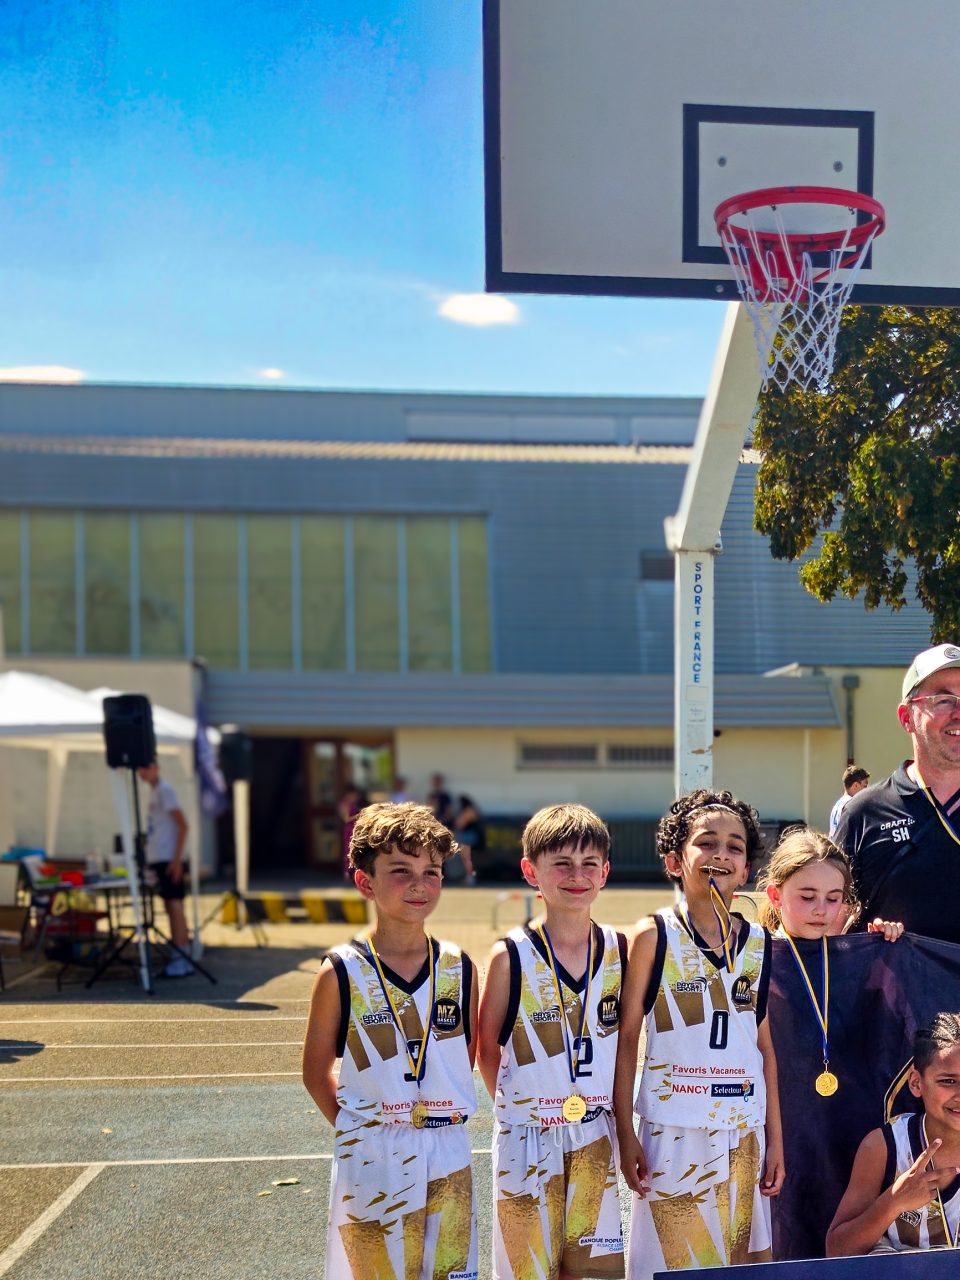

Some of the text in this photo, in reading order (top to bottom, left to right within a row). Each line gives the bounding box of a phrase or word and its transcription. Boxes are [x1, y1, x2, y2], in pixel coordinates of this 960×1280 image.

[693, 562, 702, 683] SPORT FRANCE
[880, 819, 906, 831] CRAFT
[892, 827, 910, 843] SH
[437, 1005, 455, 1018] MZ
[603, 1001, 617, 1013] MZ
[709, 1010, 728, 1049] 0
[573, 1037, 593, 1077] 2
[672, 1065, 707, 1074] Favoris
[672, 1084, 742, 1094] NANCY Selectour
[541, 1115, 577, 1126] NANC
